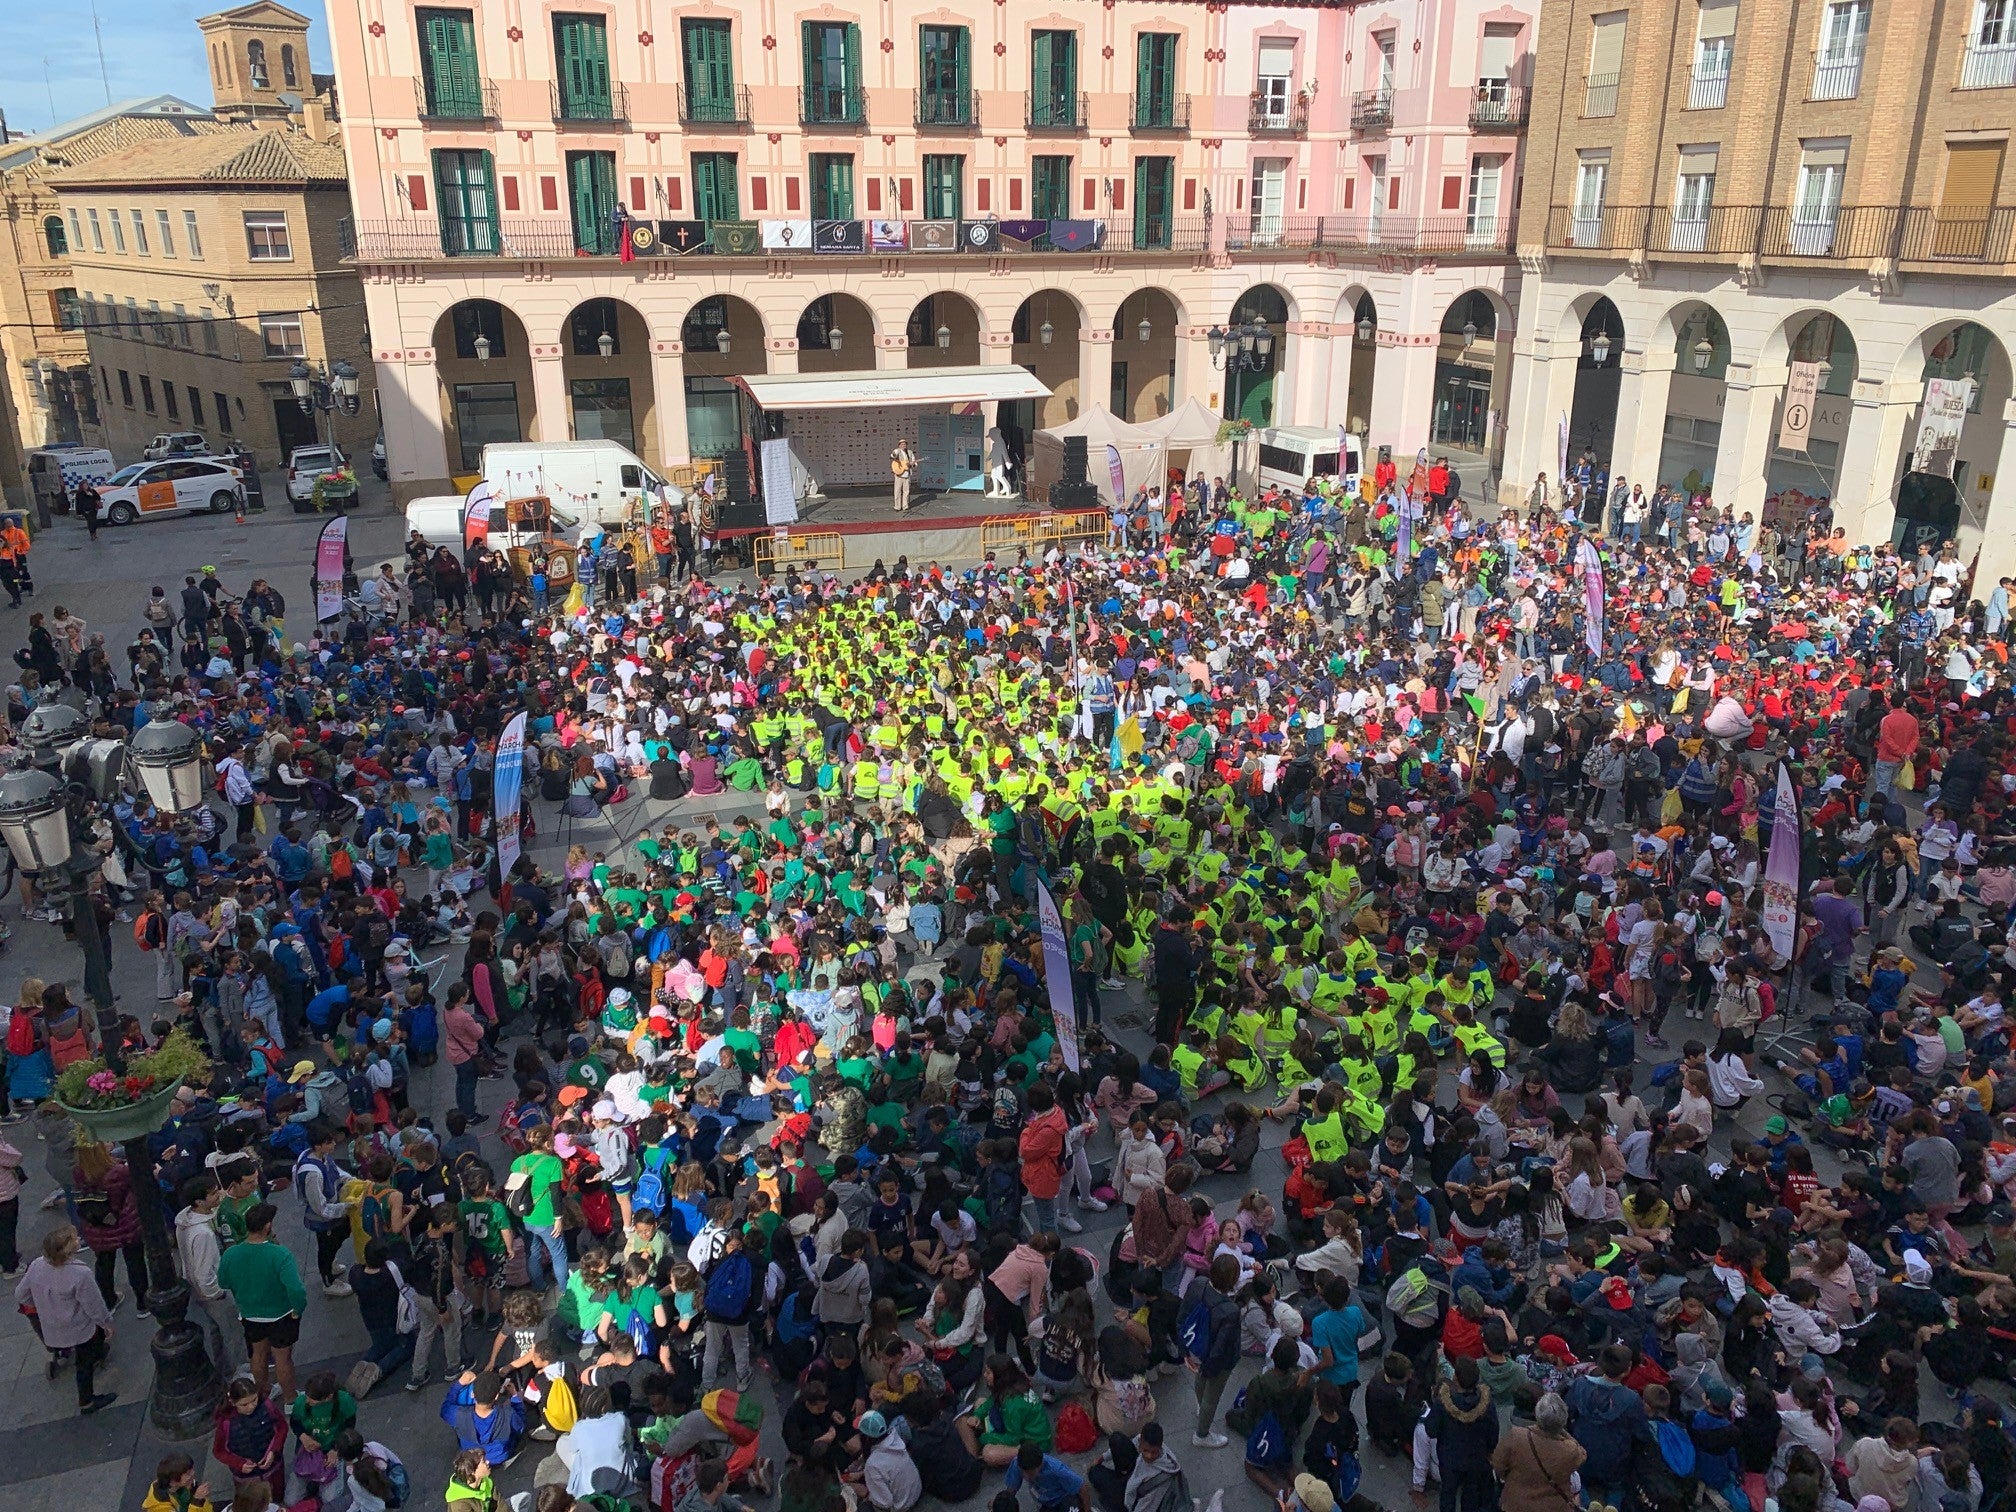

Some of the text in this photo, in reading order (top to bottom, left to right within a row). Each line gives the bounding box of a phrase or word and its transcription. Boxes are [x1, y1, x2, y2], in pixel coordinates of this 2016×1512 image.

[1796, 370, 1815, 379] Oficina
[1791, 386, 1813, 395] Turismo
[1943, 399, 1964, 412] HUESCA
[64, 458, 109, 468] POLICIA LOCAL
[580, 1064, 598, 1086] 9
[465, 1212, 488, 1239] 15
